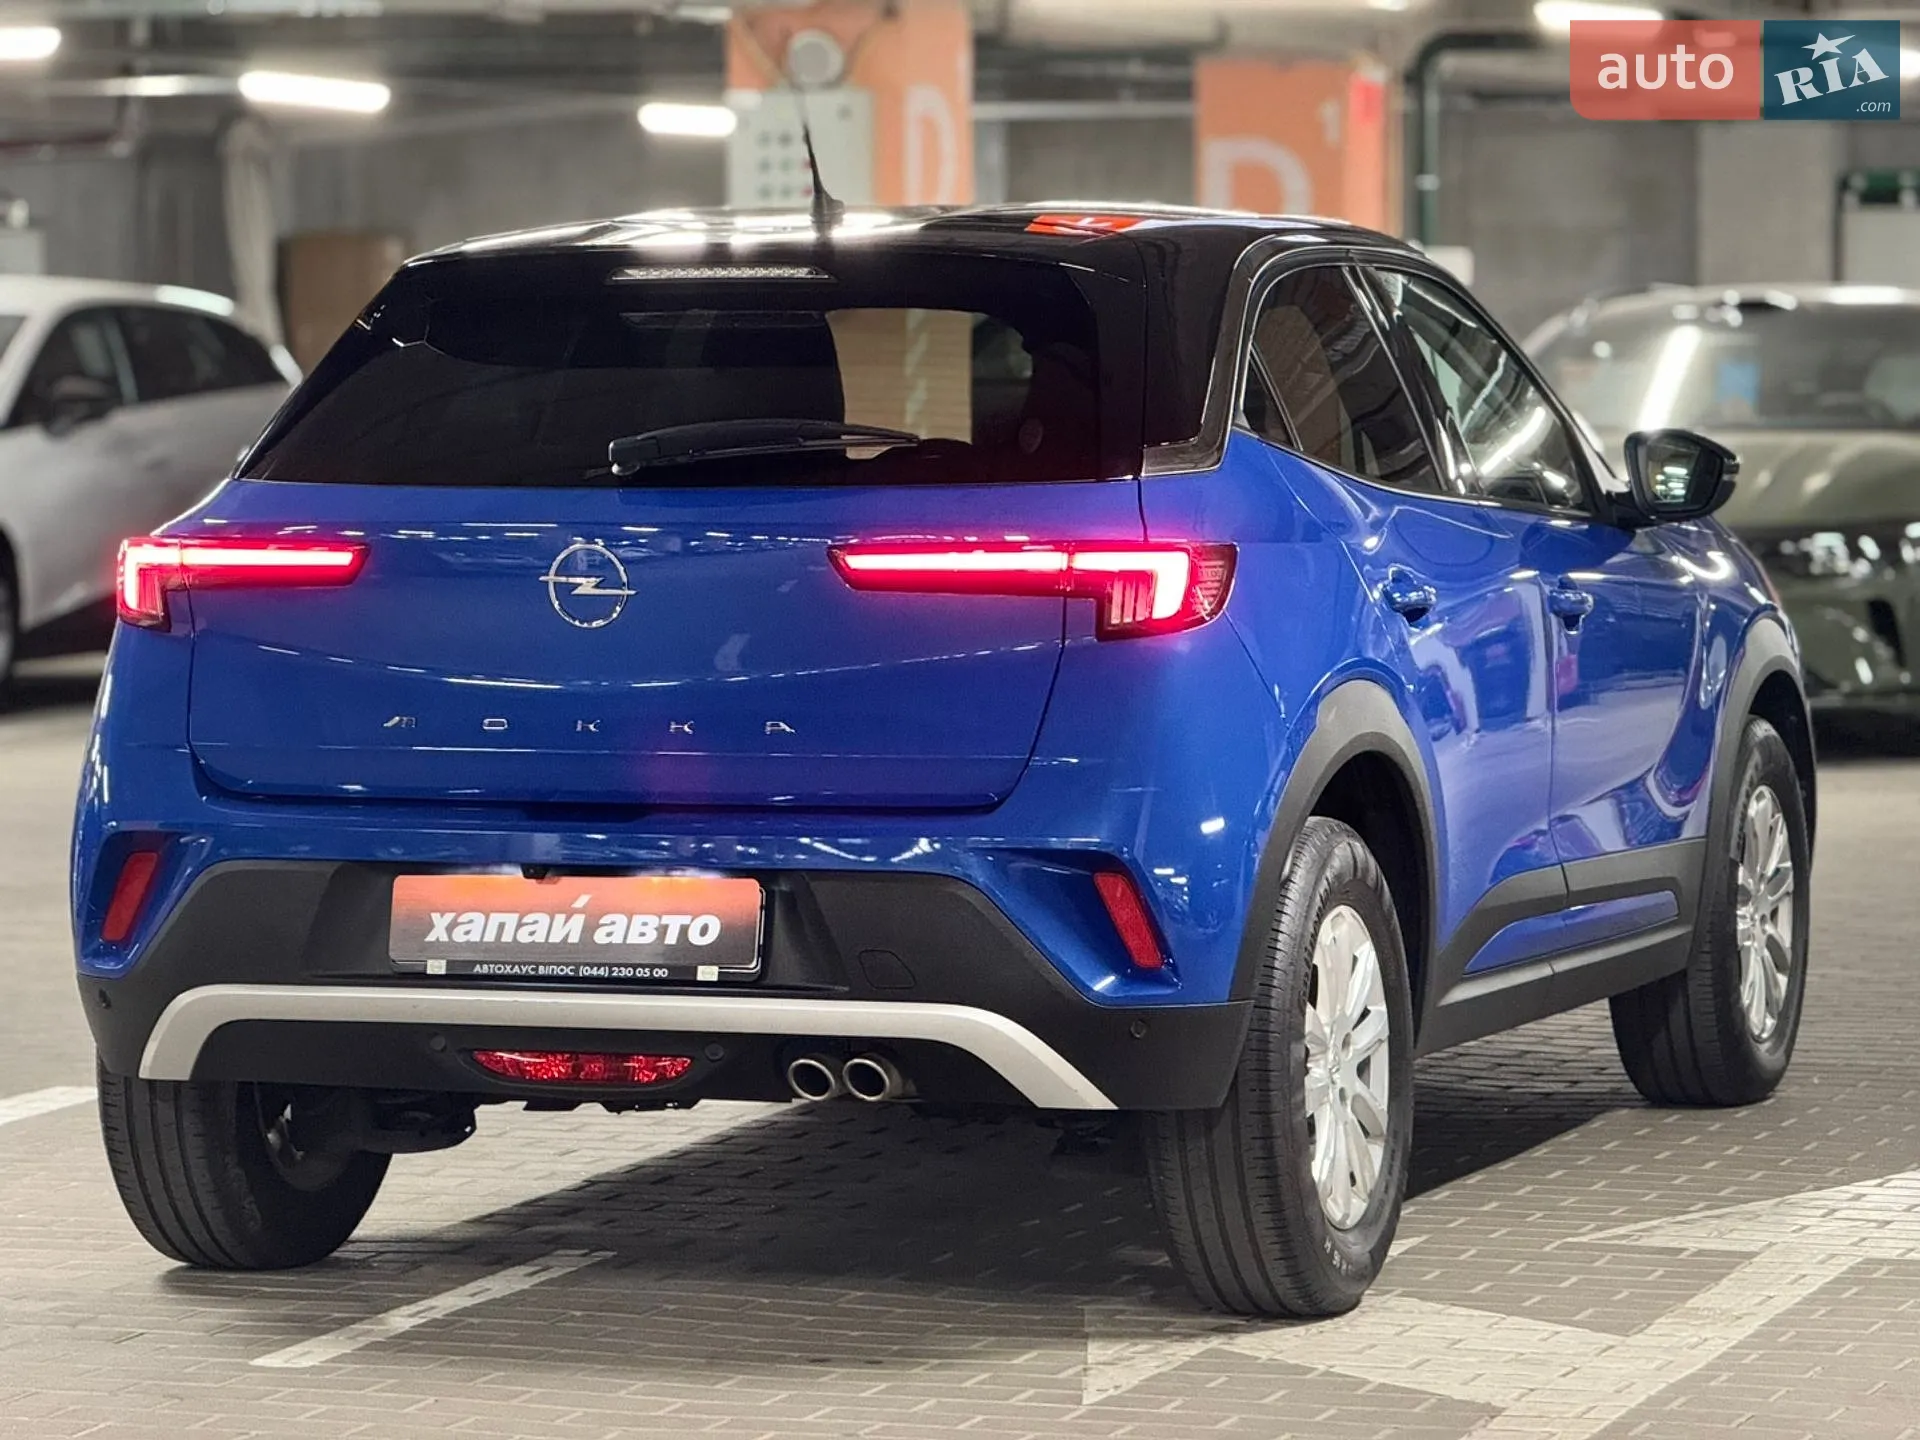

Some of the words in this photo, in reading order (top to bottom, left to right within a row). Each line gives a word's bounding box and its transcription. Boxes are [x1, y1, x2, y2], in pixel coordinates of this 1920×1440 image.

[383, 715, 796, 735] MOKKA
[425, 894, 592, 944] хапай
[592, 913, 721, 946] авто
[473, 963, 537, 975] АВТОХАУС
[538, 965, 576, 975] ВІПОС
[579, 965, 609, 977] (044)
[611, 967, 634, 977] 230
[635, 967, 651, 977] 05
[652, 968, 669, 978] 00
